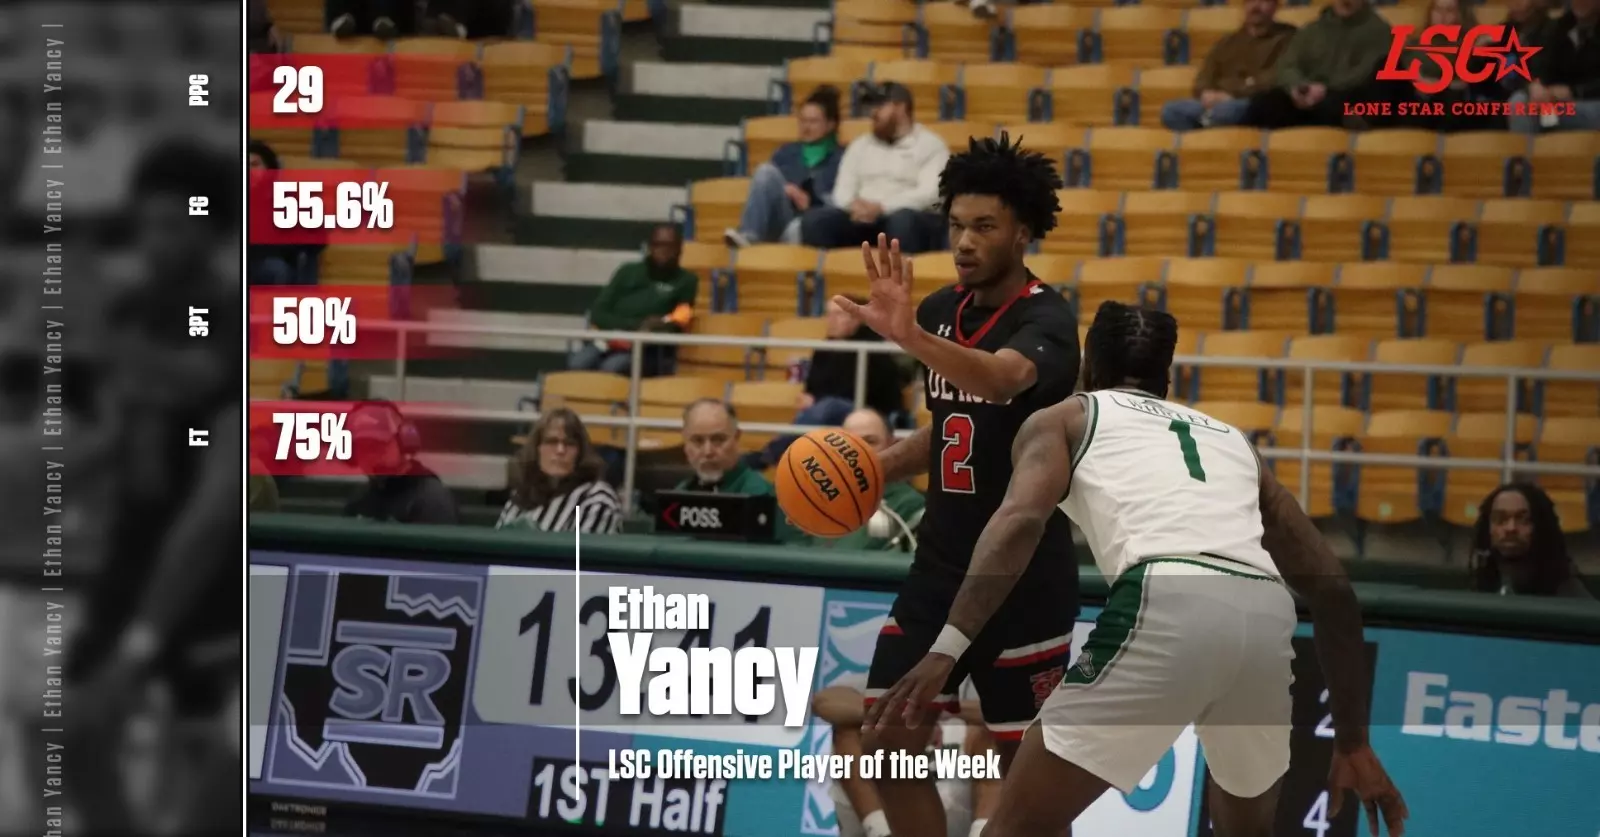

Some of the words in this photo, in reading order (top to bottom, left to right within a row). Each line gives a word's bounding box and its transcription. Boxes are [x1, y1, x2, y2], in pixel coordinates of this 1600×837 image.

[802, 456, 840, 501] NCAA
[824, 431, 869, 494] Wilson
[942, 413, 975, 494] 2
[1168, 419, 1206, 483] 1
[680, 506, 723, 528] POSS.
[329, 644, 451, 725] SR
[534, 763, 620, 827] 1ST
[628, 773, 728, 834] Half
[1302, 789, 1331, 837] 4
